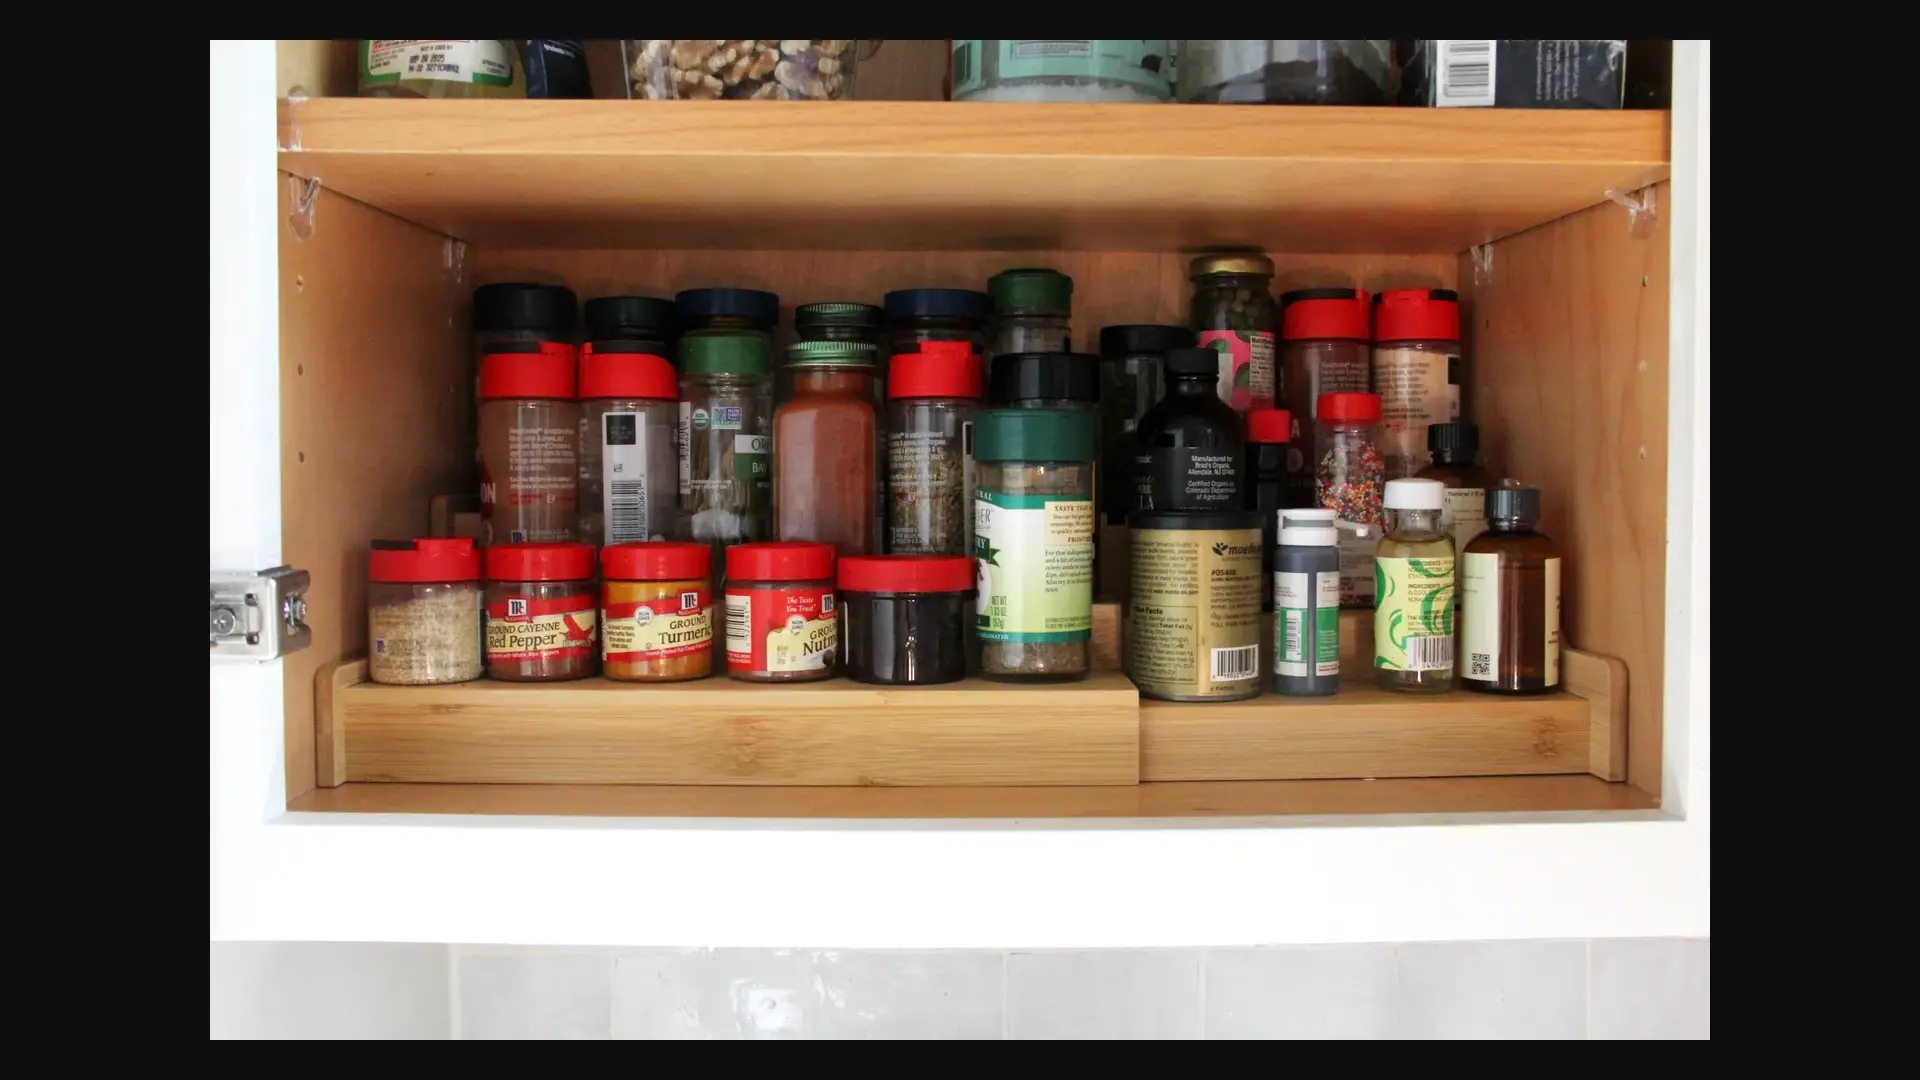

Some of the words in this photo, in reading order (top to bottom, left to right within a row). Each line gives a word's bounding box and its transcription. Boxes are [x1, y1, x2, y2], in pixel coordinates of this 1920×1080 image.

[518, 622, 560, 634] CAYENNE
[670, 616, 706, 630] GROUND
[489, 637, 506, 648] Red
[508, 632, 557, 650] Pepper
[658, 628, 711, 645] Turmeric
